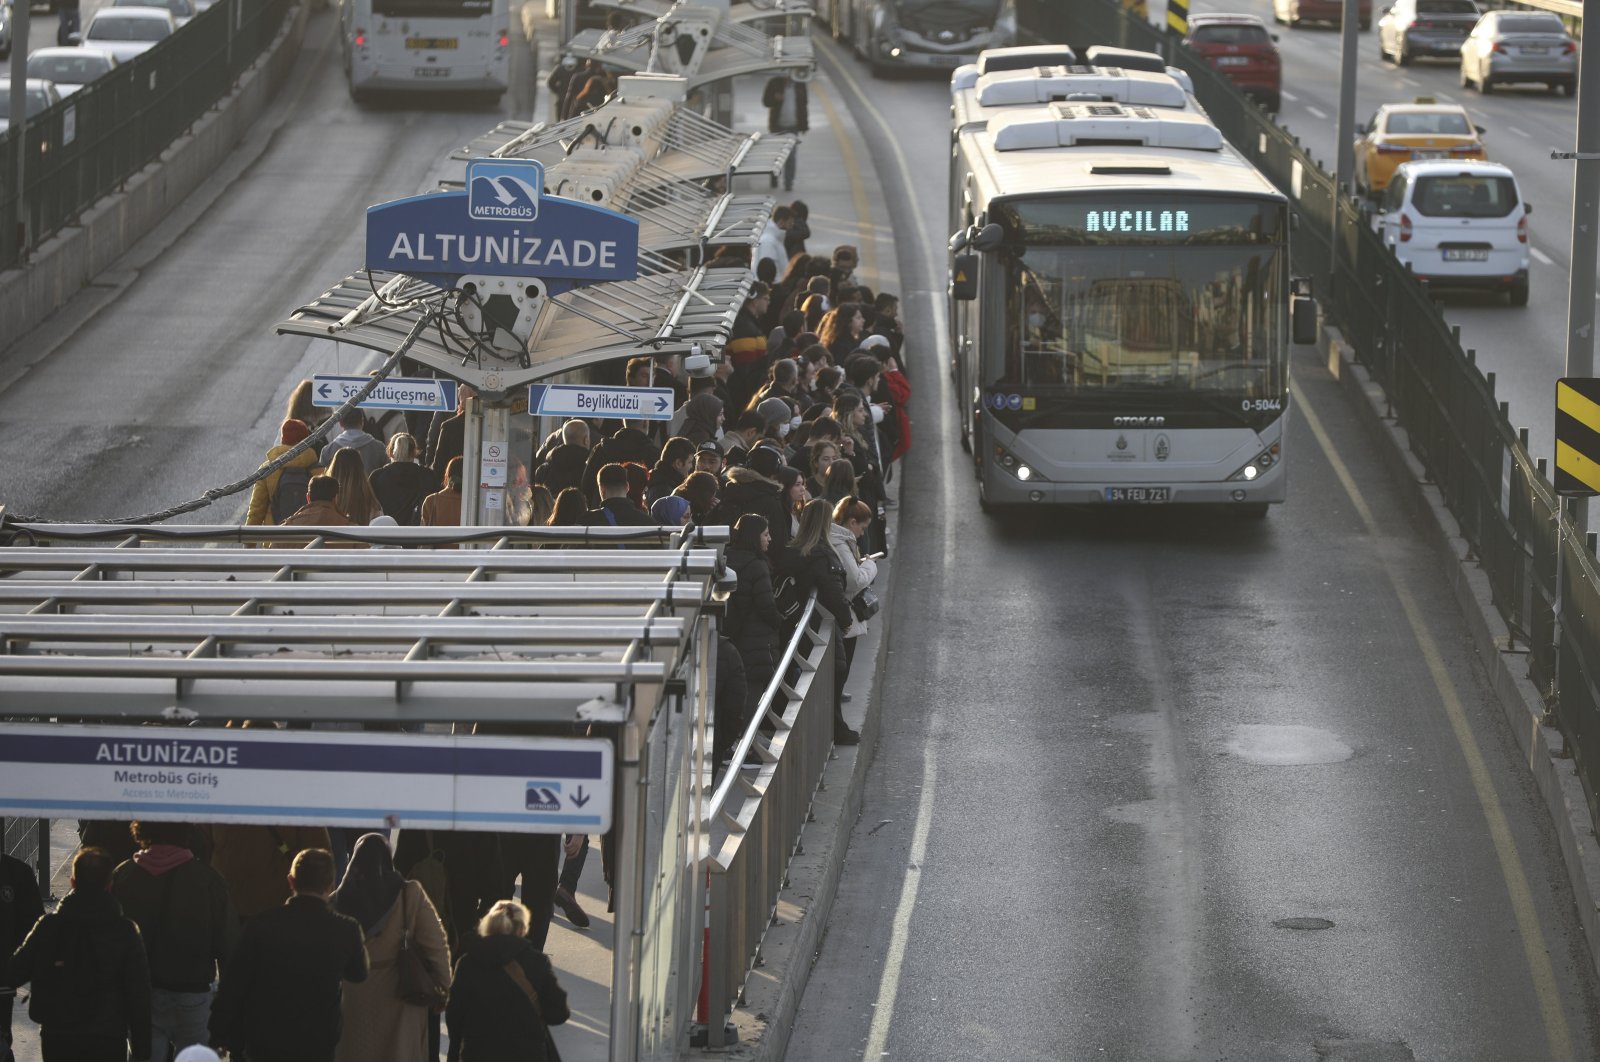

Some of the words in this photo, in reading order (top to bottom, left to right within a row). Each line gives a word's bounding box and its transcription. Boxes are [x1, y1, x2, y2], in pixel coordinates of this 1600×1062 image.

[474, 205, 532, 217] METROBÜS
[1086, 211, 1189, 232] AVCILAR
[388, 229, 617, 269] ALTUNİZADE
[342, 385, 436, 404] Söutlüçeşme
[577, 393, 639, 412] Beylikdüzü
[1113, 416, 1165, 426] OTOKAR
[1112, 489, 1124, 500] 34
[95, 741, 239, 765] ALTUNİZADE
[114, 770, 183, 784] Metrobüs
[186, 772, 219, 788] Giriş
[122, 788, 153, 798] Access
[154, 789, 165, 799] to
